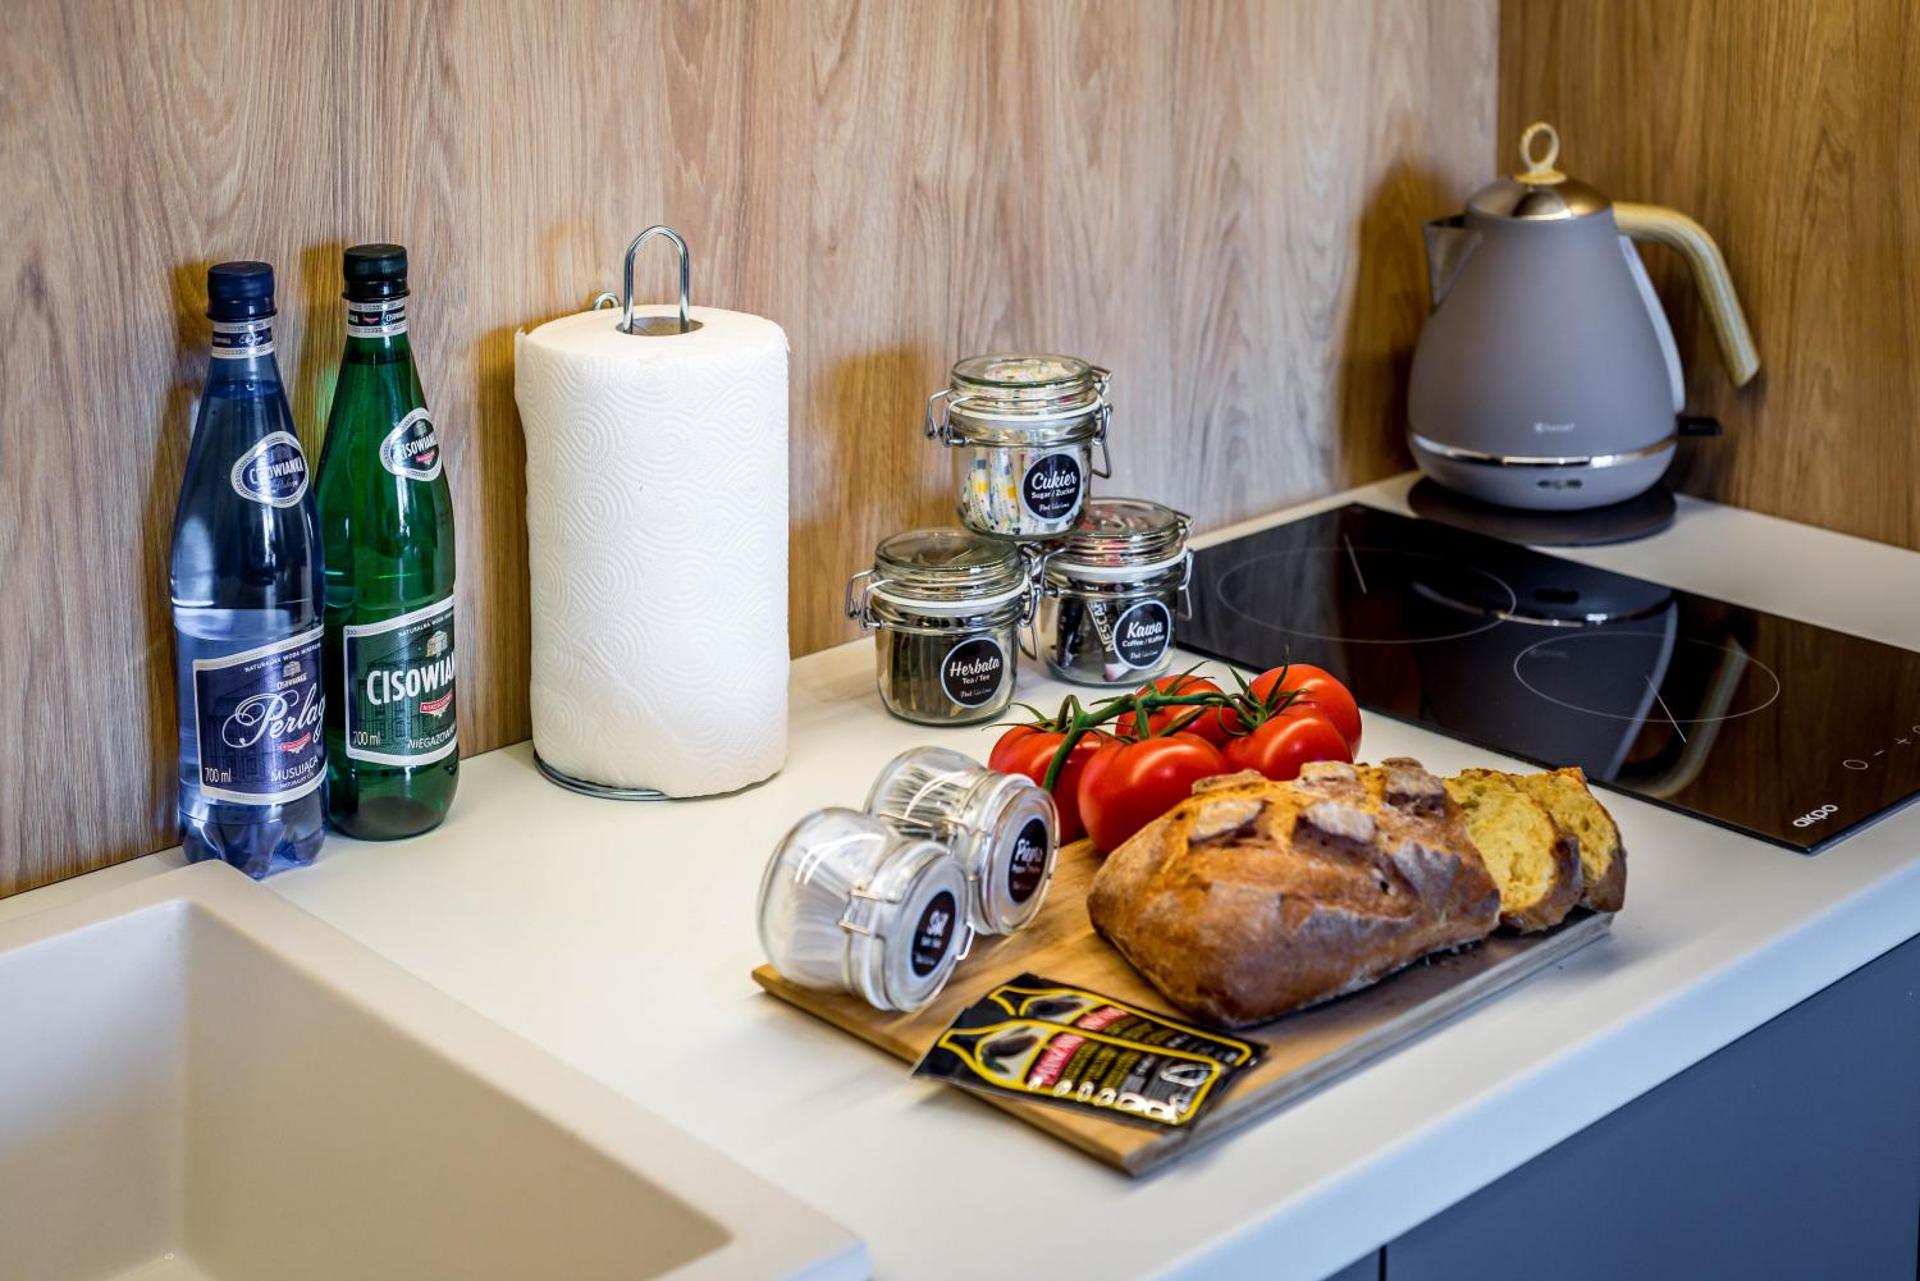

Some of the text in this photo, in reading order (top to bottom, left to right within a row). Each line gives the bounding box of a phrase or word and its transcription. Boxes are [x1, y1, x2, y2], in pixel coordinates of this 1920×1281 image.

[1031, 470, 1077, 490] Cukier
[1127, 621, 1164, 639] Kawa
[950, 656, 1000, 678] Herbata
[962, 677, 975, 685] Tea
[353, 730, 381, 746] 700 ml
[204, 767, 232, 783] 700 ml
[1792, 804, 1839, 828] akpo
